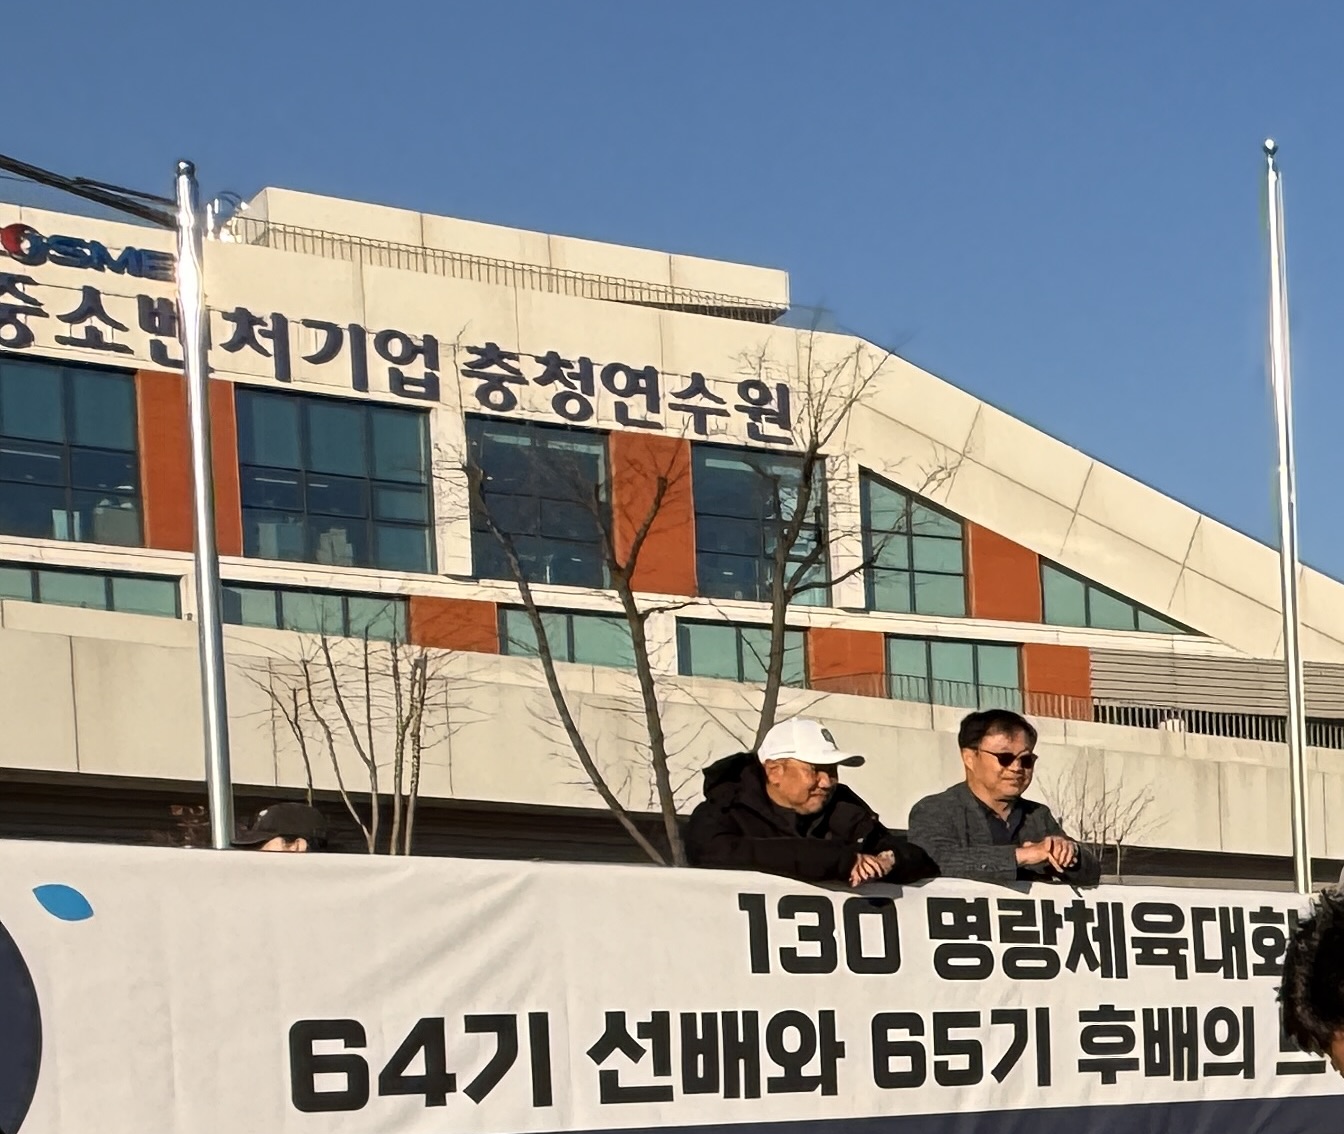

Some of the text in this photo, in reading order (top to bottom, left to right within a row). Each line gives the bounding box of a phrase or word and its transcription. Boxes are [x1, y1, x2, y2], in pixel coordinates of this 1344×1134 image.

[0, 223, 177, 282] OSME
[461, 341, 793, 446] 충청연수원
[738, 893, 902, 975] 130
[289, 1011, 553, 1112] 64기
[586, 1009, 845, 1105] 선배와
[870, 1006, 1052, 1089] 65기
[1077, 1005, 1256, 1084] 후배의
